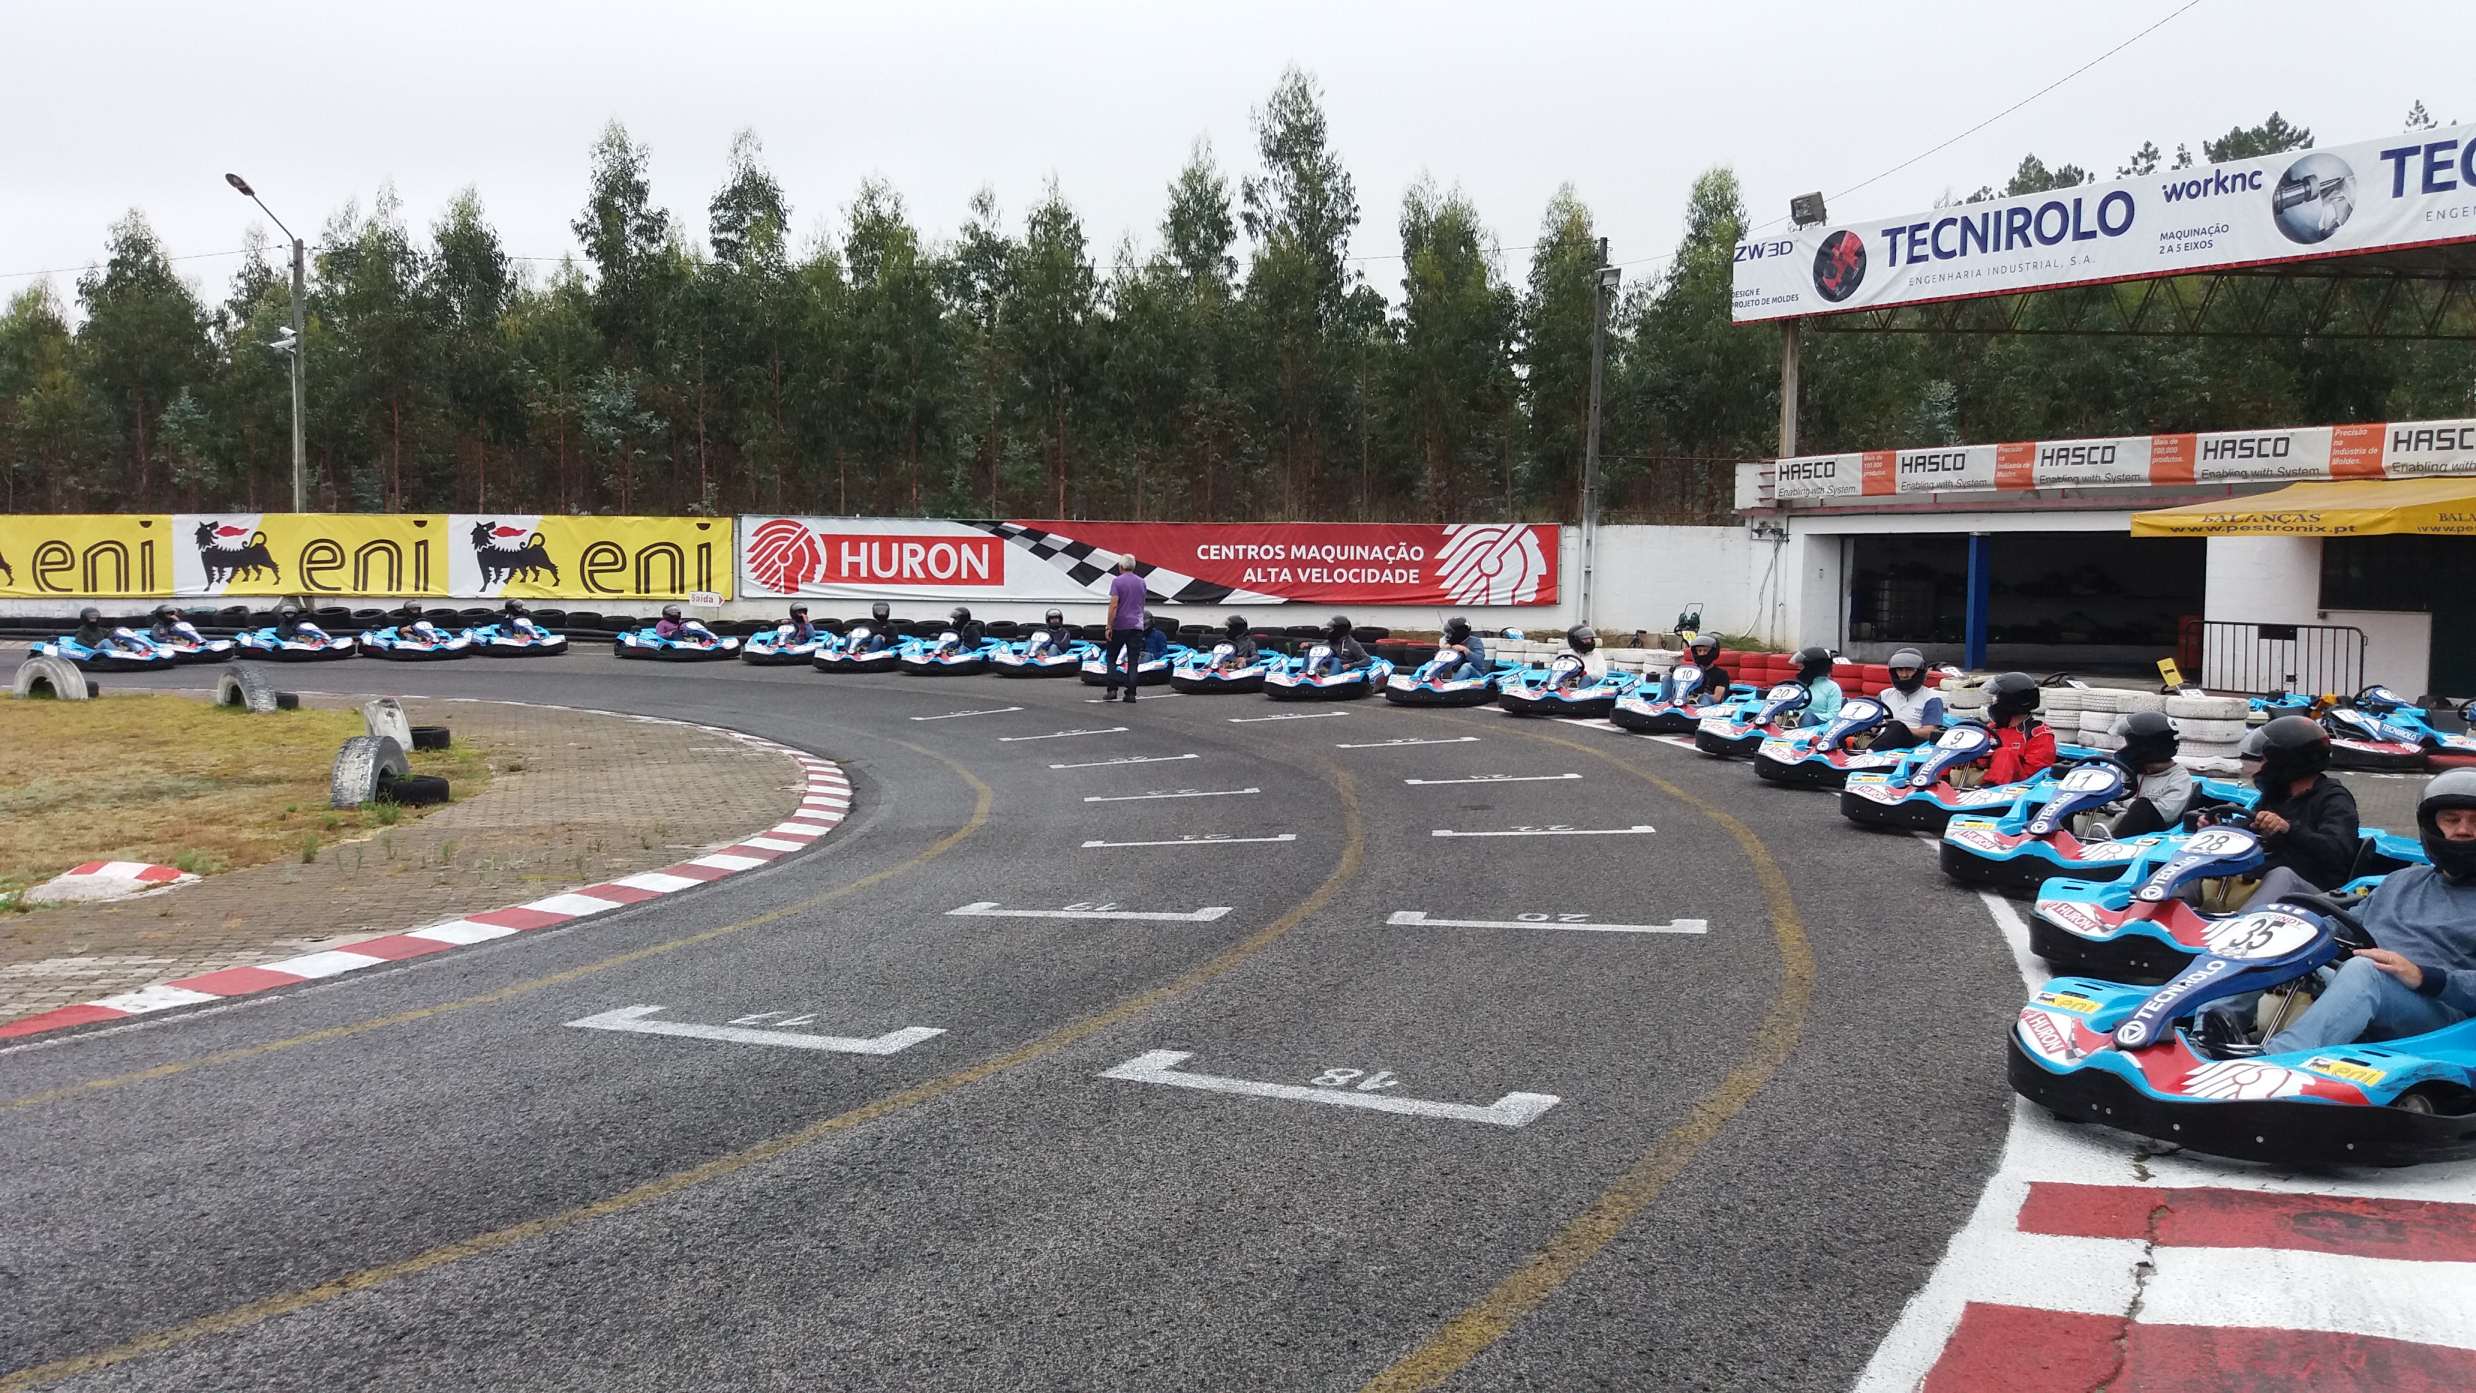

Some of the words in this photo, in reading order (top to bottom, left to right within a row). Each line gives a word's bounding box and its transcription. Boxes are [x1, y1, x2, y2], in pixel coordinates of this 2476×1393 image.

[2162, 169, 2263, 203] worknc
[2426, 206, 2476, 222] ENGE
[1881, 190, 2136, 268] TECNIROLO
[2160, 223, 2229, 241] MAQUINAÇÃO
[2160, 245, 2165, 255] 2
[2167, 244, 2174, 254] A
[2176, 243, 2182, 252] 5
[2184, 240, 2213, 251] EIXOS
[1908, 269, 1982, 286] ENGENHARIA
[1771, 294, 1799, 304] MOLDES
[2040, 445, 2116, 467] HASCO
[2202, 436, 2290, 460] HASCO
[1779, 461, 1835, 481] HASCO
[1901, 453, 1966, 473] HASCO
[2039, 474, 2080, 485] Enabling
[2081, 473, 2101, 483] with
[2104, 472, 2141, 484] System
[2201, 468, 2248, 480] Enabling
[2251, 467, 2273, 478] with
[2277, 466, 2320, 479] System
[1827, 484, 1856, 495] System
[32, 520, 154, 593] eni
[300, 520, 429, 592] eni
[580, 522, 712, 594] eni
[841, 540, 990, 579] HURON
[1197, 544, 1285, 560] CENTROS
[1290, 542, 1424, 564] MAQUINAÇÃO
[1243, 567, 1292, 583] ALTA
[1298, 568, 1420, 584] VELOCIDADE
[1682, 670, 1693, 679] 10
[1773, 688, 1790, 698] 20
[1950, 731, 1965, 745] 9
[2066, 773, 2094, 788] 11
[2190, 834, 2230, 851] 28
[1517, 913, 1590, 922] 20
[2056, 903, 2094, 931] HURON
[2228, 919, 2286, 950] 35
[2029, 1015, 2062, 1052] HURON
[1310, 1067, 1400, 1091] 18
